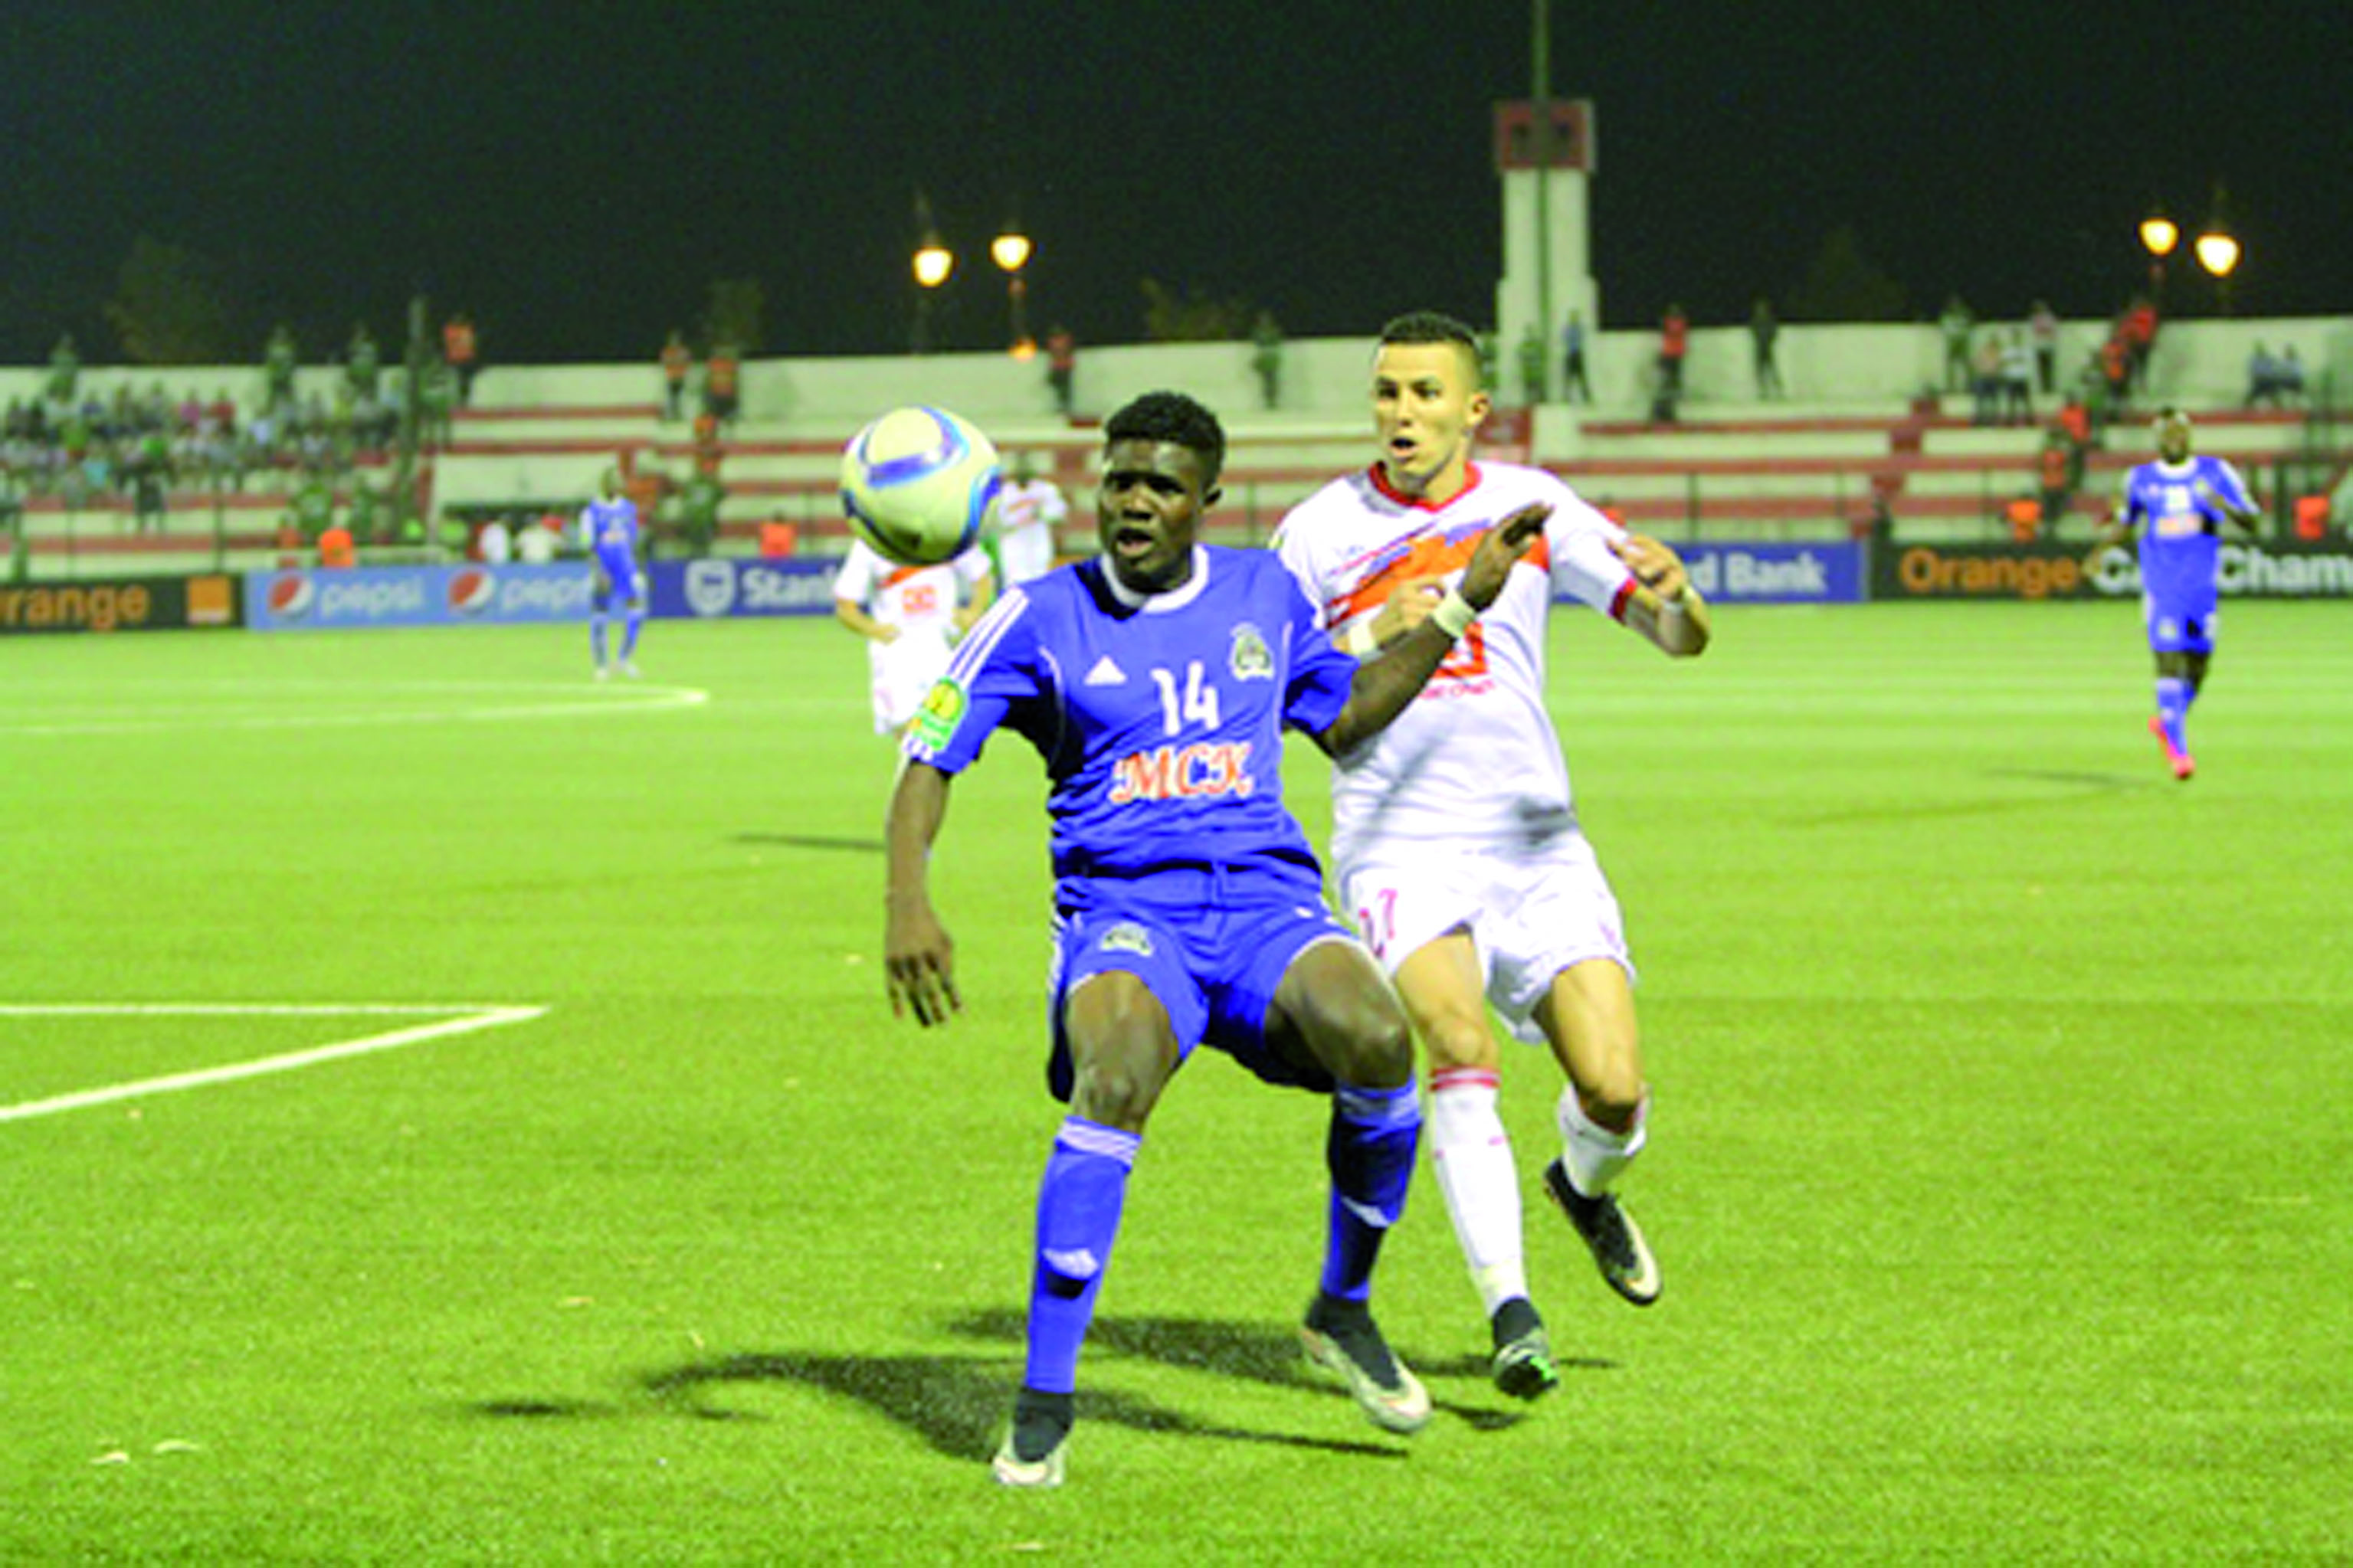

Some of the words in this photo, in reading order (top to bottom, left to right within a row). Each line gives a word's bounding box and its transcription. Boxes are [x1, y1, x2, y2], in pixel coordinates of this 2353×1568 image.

[503, 576, 595, 611] peps
[1725, 551, 1828, 594] Bank
[1899, 548, 2078, 597] Orange
[0, 584, 150, 630] range
[320, 578, 424, 617] pepsi
[1151, 661, 1220, 736] 14
